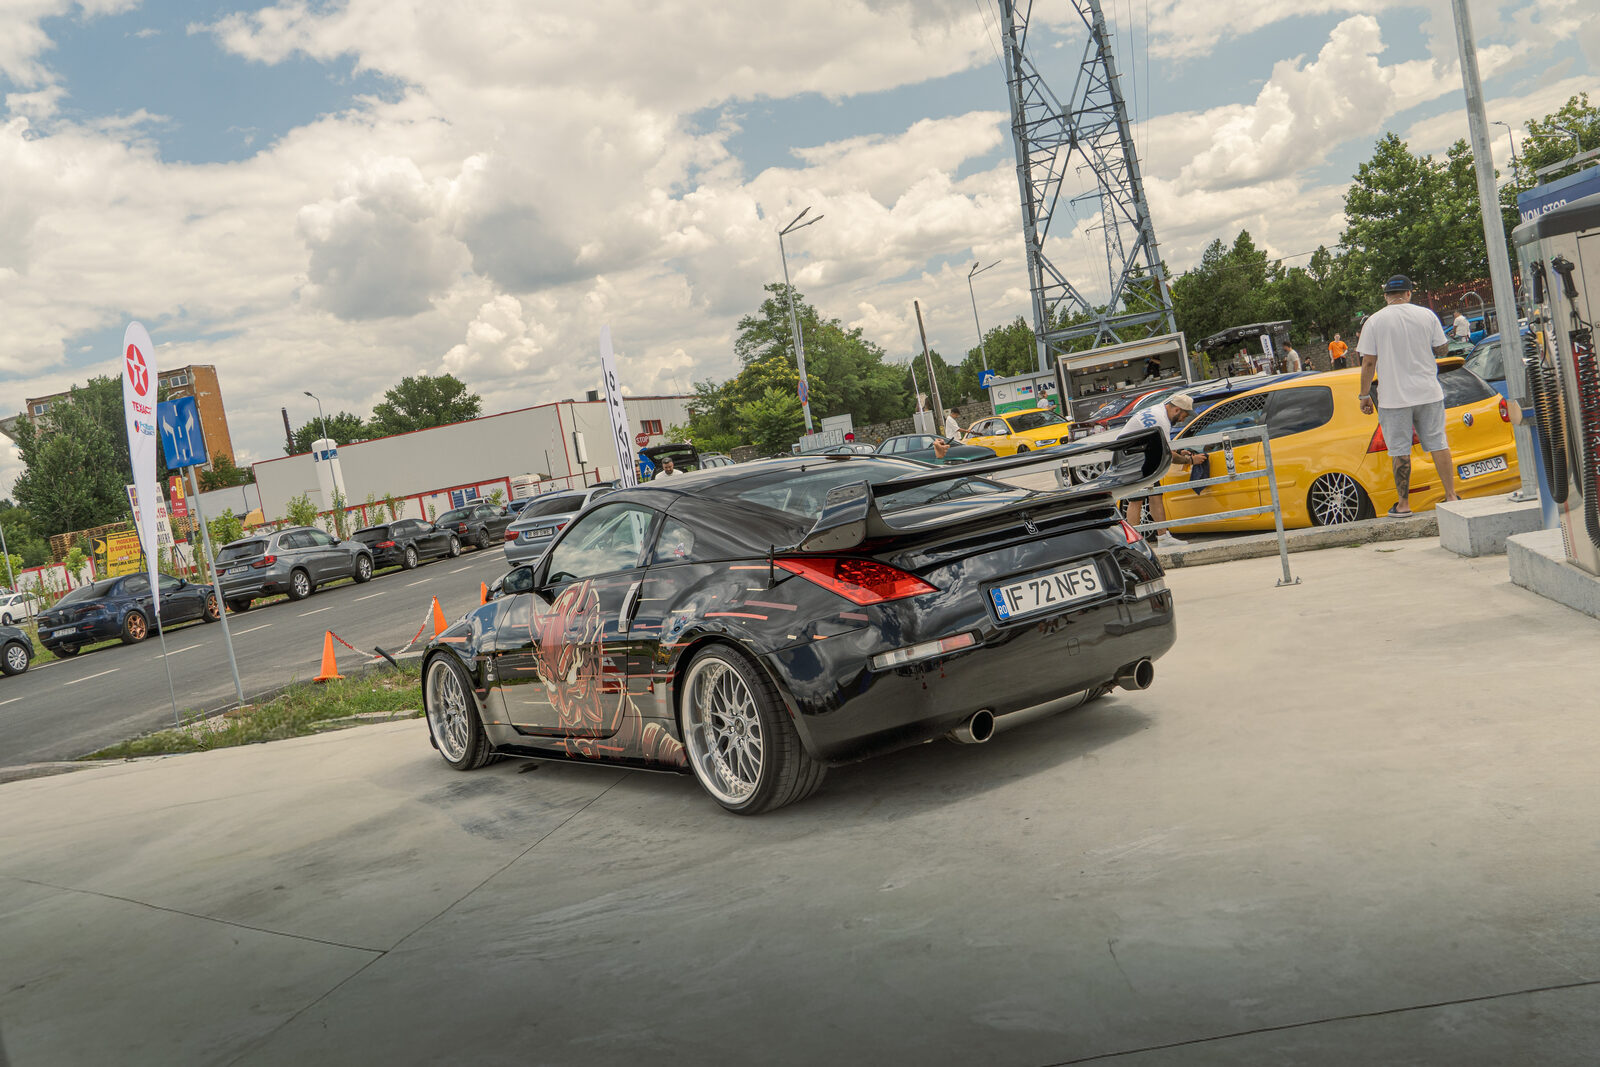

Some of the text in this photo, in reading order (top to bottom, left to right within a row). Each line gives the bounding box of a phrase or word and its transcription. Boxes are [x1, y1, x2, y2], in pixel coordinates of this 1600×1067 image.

[1521, 208, 1540, 224] NON
[1038, 382, 1055, 392] FAN
[636, 436, 649, 444] STOP
[1462, 466, 1470, 476] B
[1005, 568, 1096, 612] IF 72 NFS
[998, 605, 1008, 615] RO
